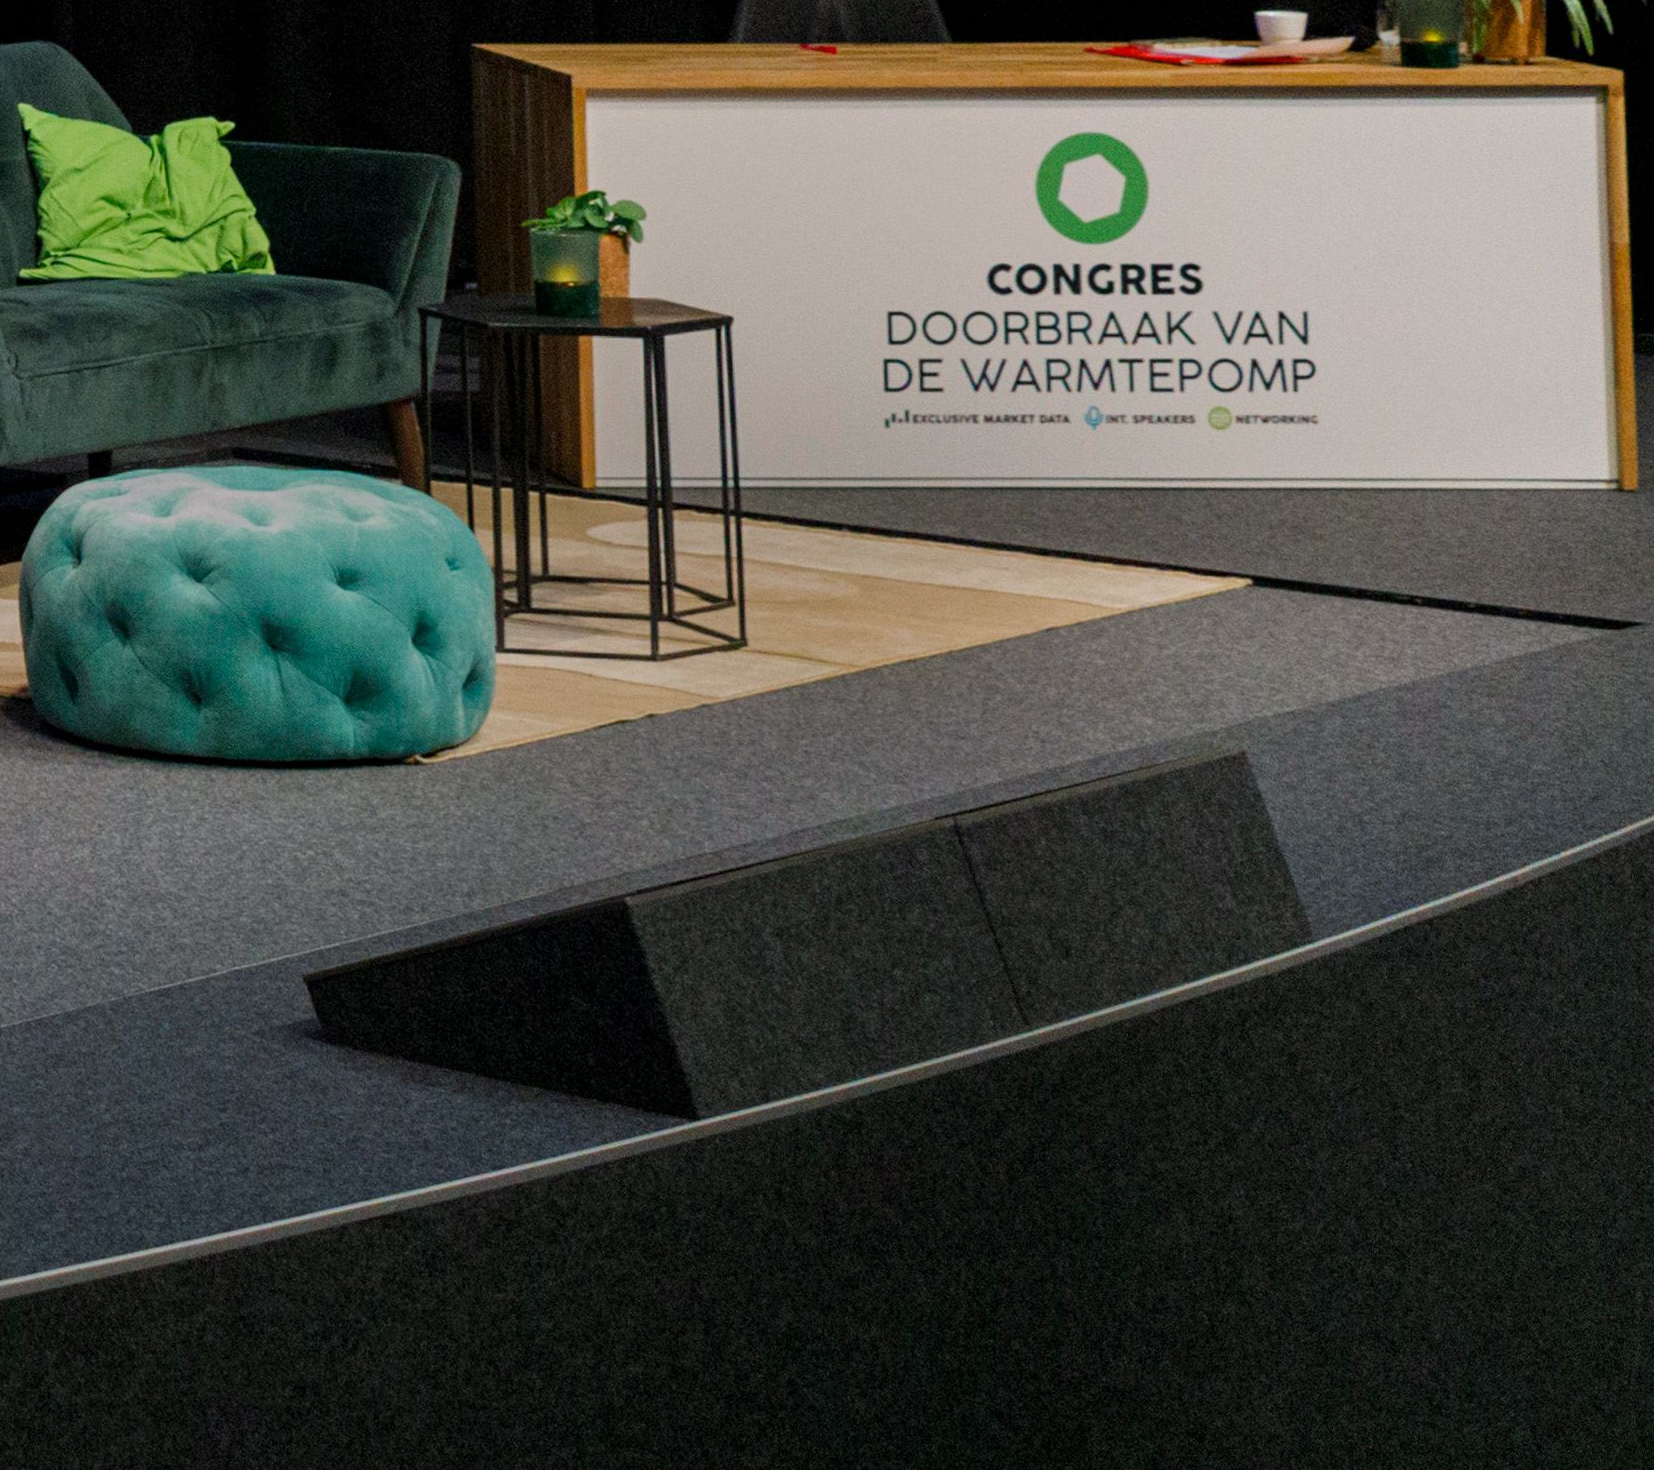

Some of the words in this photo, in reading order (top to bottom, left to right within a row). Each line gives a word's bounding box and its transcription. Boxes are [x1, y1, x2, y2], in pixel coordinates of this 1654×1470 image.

[987, 262, 1204, 296] CONGRES
[887, 311, 1196, 346] DOORBRAAK
[1213, 311, 1308, 345] VAN
[883, 359, 944, 392] DE
[961, 358, 1316, 393] WARMTEPOMP
[912, 413, 979, 425] EXCLUSIVE
[983, 413, 1035, 425] MARKET
[1039, 413, 1071, 425] DATA
[1105, 414, 1127, 425] INT.
[1132, 414, 1196, 425] SPEAKERS
[1235, 414, 1319, 425] NETWORKING
